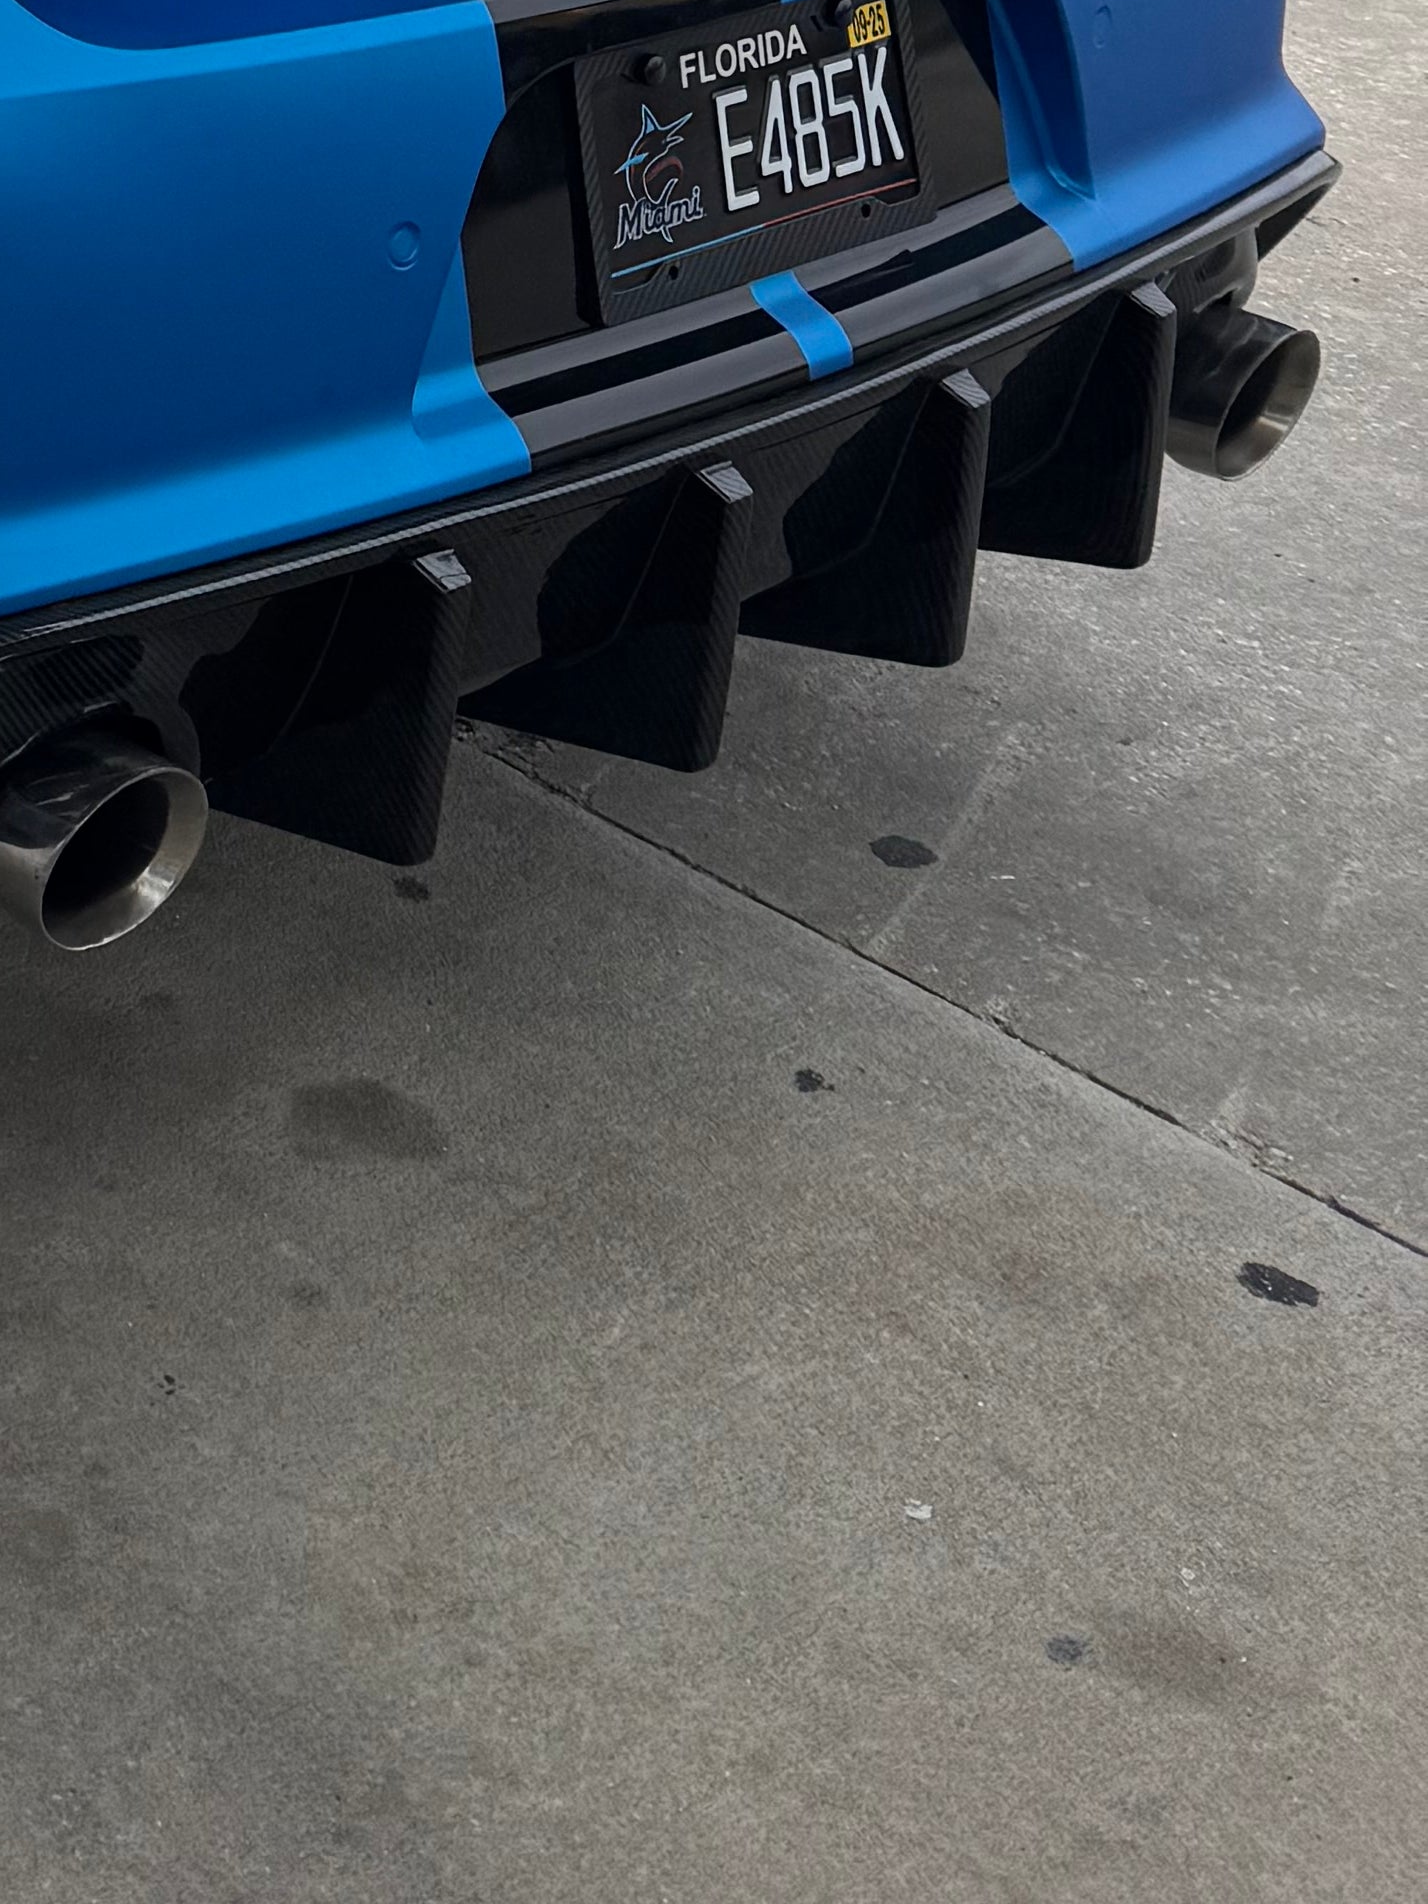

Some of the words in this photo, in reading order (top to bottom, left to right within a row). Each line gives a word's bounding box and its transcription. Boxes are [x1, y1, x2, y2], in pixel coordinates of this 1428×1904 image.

[852, 3, 886, 43] 09-25
[679, 23, 807, 89] FLORIDA
[715, 46, 904, 212] E485K
[613, 185, 704, 250] Miami
